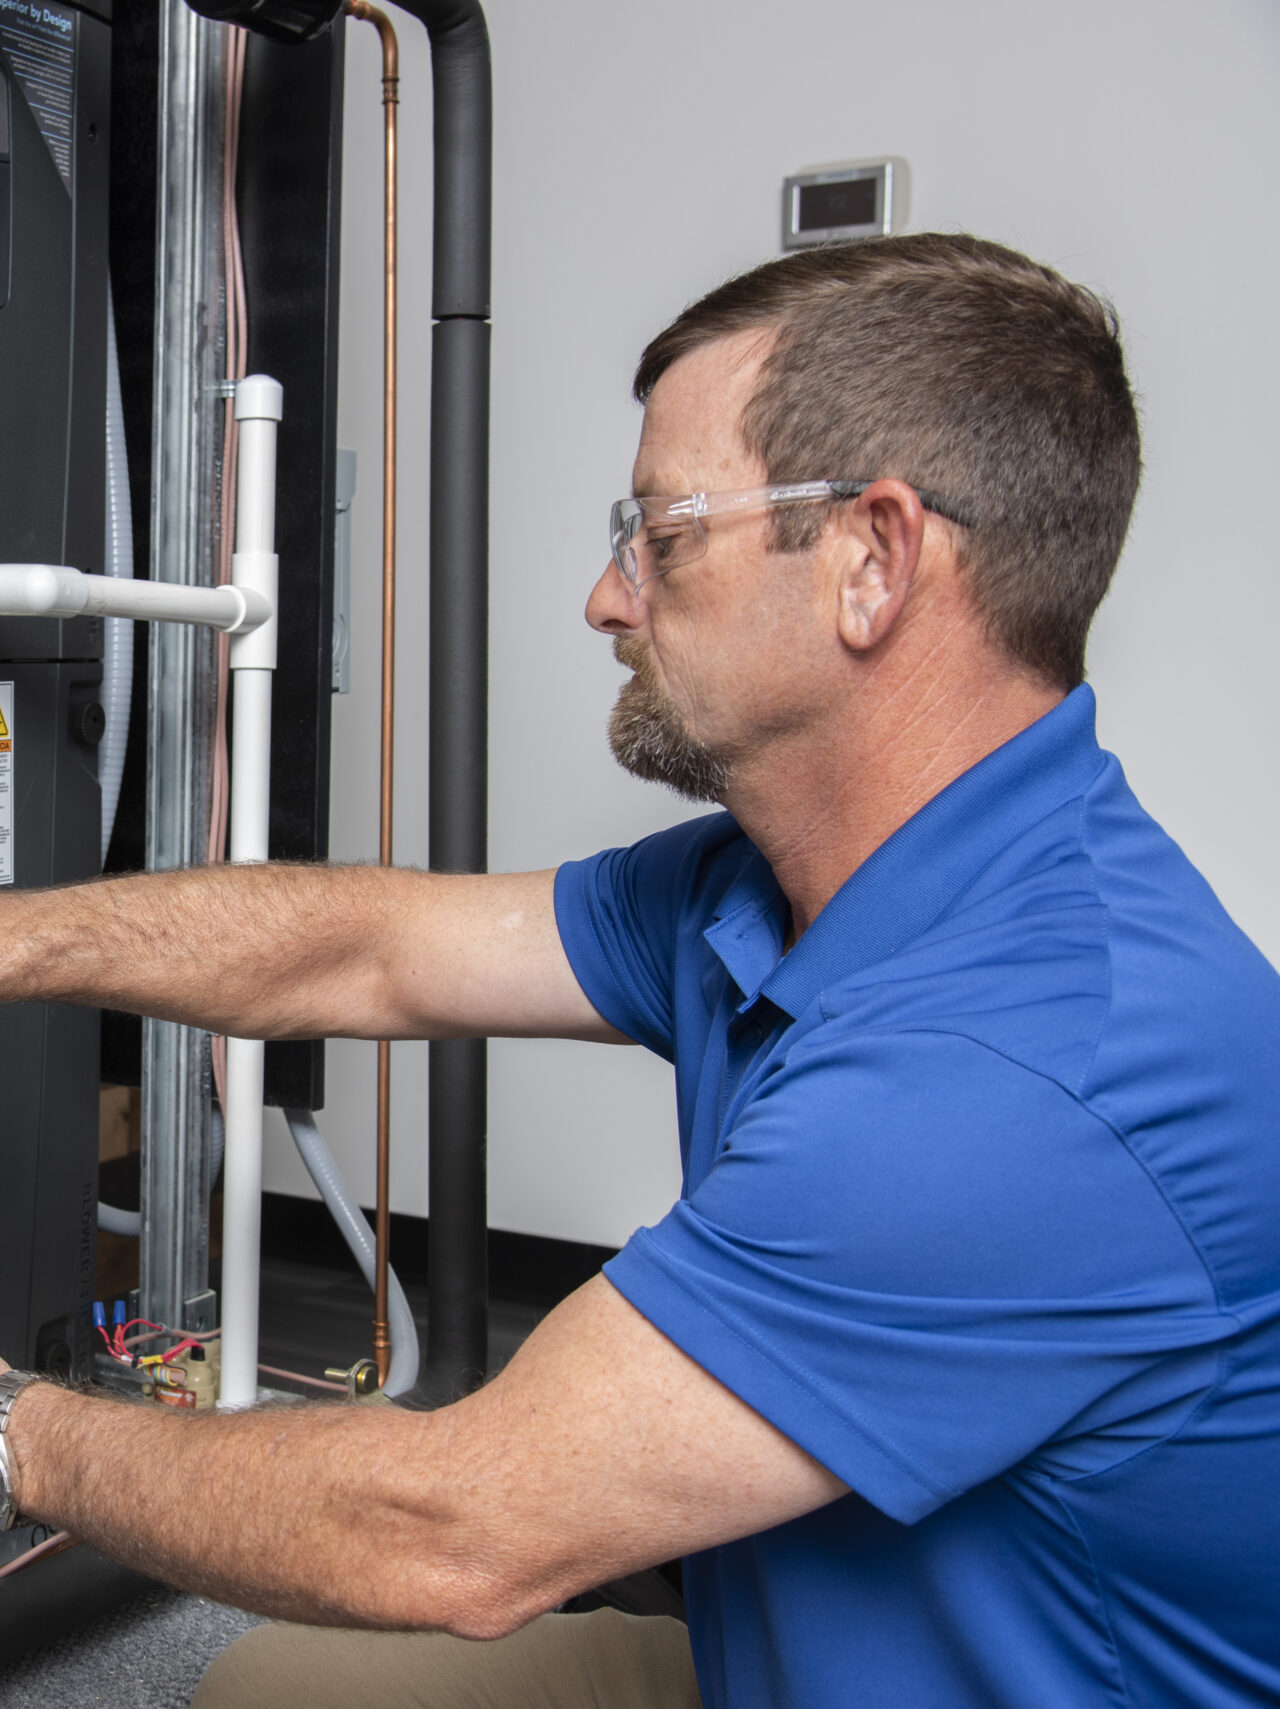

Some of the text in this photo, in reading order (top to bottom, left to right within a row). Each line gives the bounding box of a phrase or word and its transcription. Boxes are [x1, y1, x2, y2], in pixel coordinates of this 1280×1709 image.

[30, 4, 41, 22] by
[43, 9, 72, 32] Design
[80, 1183, 93, 1274] BLOWER
